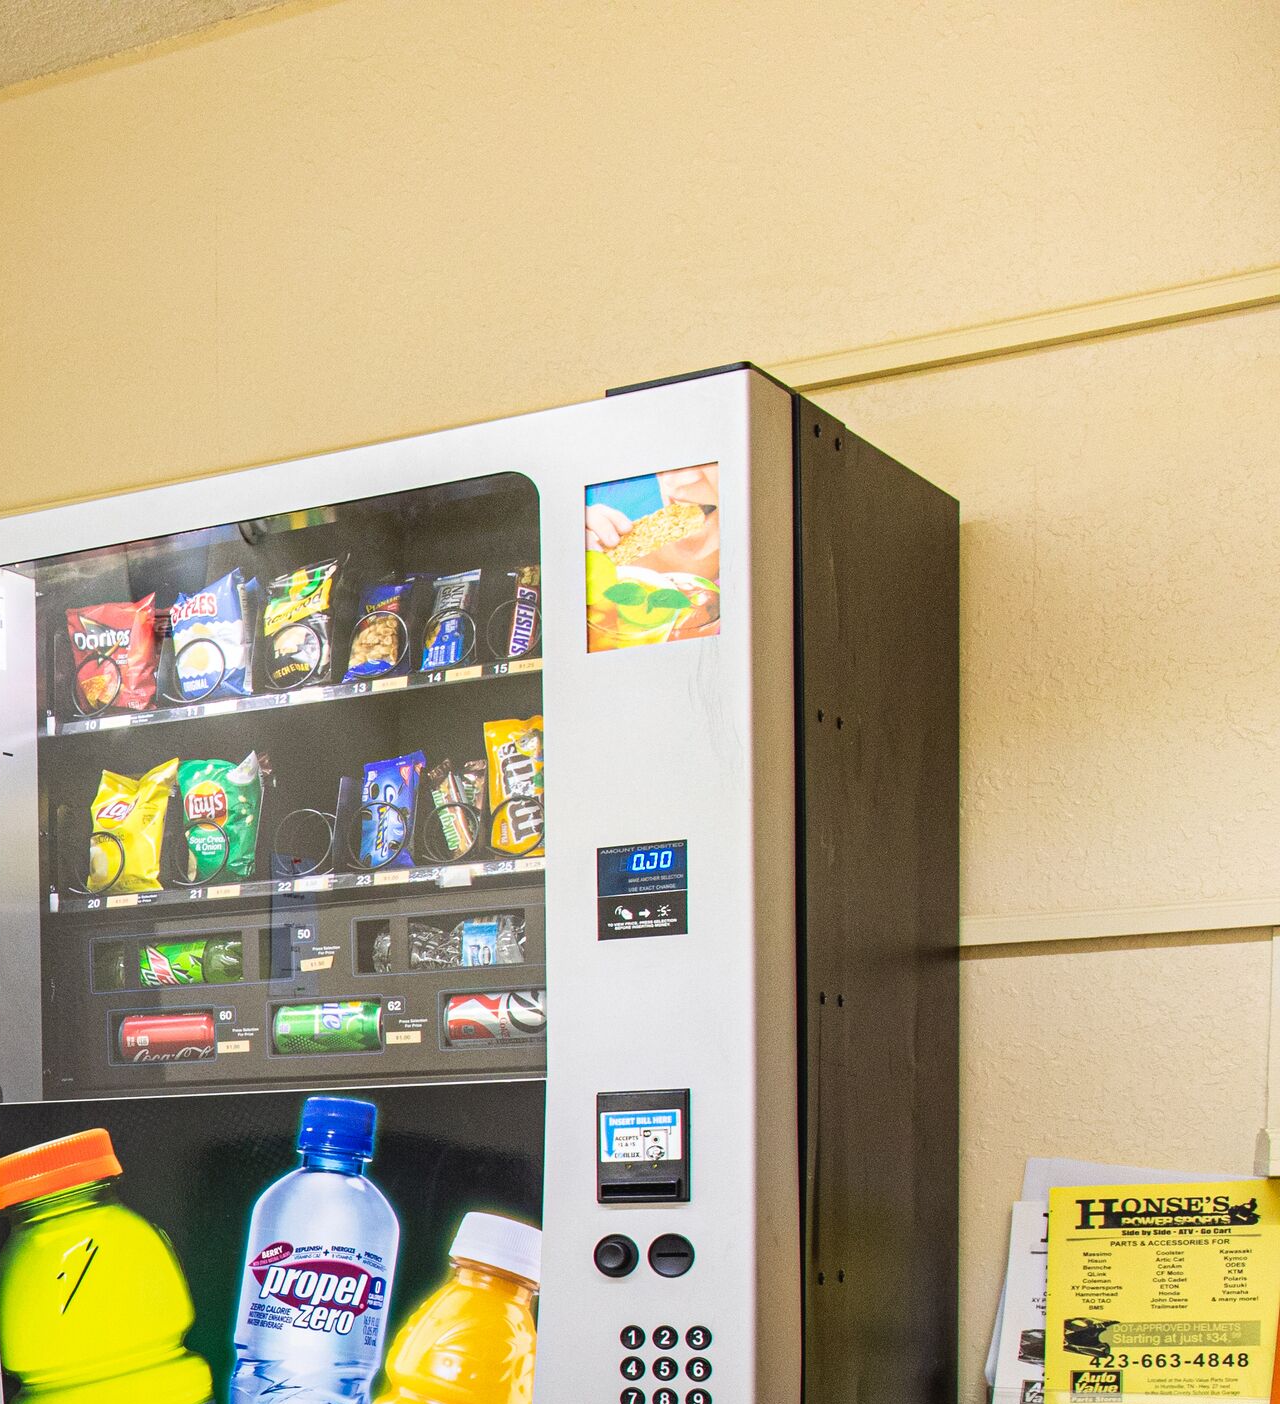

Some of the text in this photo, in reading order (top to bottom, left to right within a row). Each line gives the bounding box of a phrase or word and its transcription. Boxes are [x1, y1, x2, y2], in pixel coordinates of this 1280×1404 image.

[510, 587, 536, 655] SATISFIS
[74, 629, 130, 650] Doritos
[494, 664, 508, 673] 15
[428, 674, 441, 682] 14
[352, 683, 367, 692] 13
[274, 694, 287, 704] 12
[85, 721, 96, 730] 10
[188, 794, 223, 819] Lay's
[190, 836, 205, 844] Sour
[601, 842, 684, 854] AMOUNT DEPOSITED
[498, 862, 512, 871] 25
[357, 875, 371, 884] 23
[278, 883, 291, 891] 22
[190, 890, 202, 898] 21
[88, 899, 100, 908] 20
[297, 930, 310, 939] 50
[388, 1001, 401, 1011] 62
[220, 1011, 231, 1020] 60
[609, 1116, 672, 1126] INSERT BILL HERE
[1075, 1196, 1229, 1229] HONSE'S
[262, 1246, 283, 1259] BERRY
[295, 1245, 322, 1253] REPLENISH
[259, 1266, 368, 1306] propel
[375, 1281, 381, 1293] 0
[251, 1303, 292, 1315] ZERO CALORIE
[249, 1312, 293, 1323] NUTRIENT ENHANCED
[293, 1305, 355, 1335] zero
[260, 1320, 283, 1330] BEVERAGE
[1114, 1323, 1240, 1332] DOT-APPROVED HELMETS
[628, 1330, 703, 1345] 1 2 3
[1113, 1332, 1202, 1345] Starting at just
[1090, 1353, 1249, 1368] 423-663-4848
[627, 1361, 704, 1377] 4 5 6
[1078, 1372, 1117, 1383] Auto
[1074, 1382, 1118, 1393] Value
